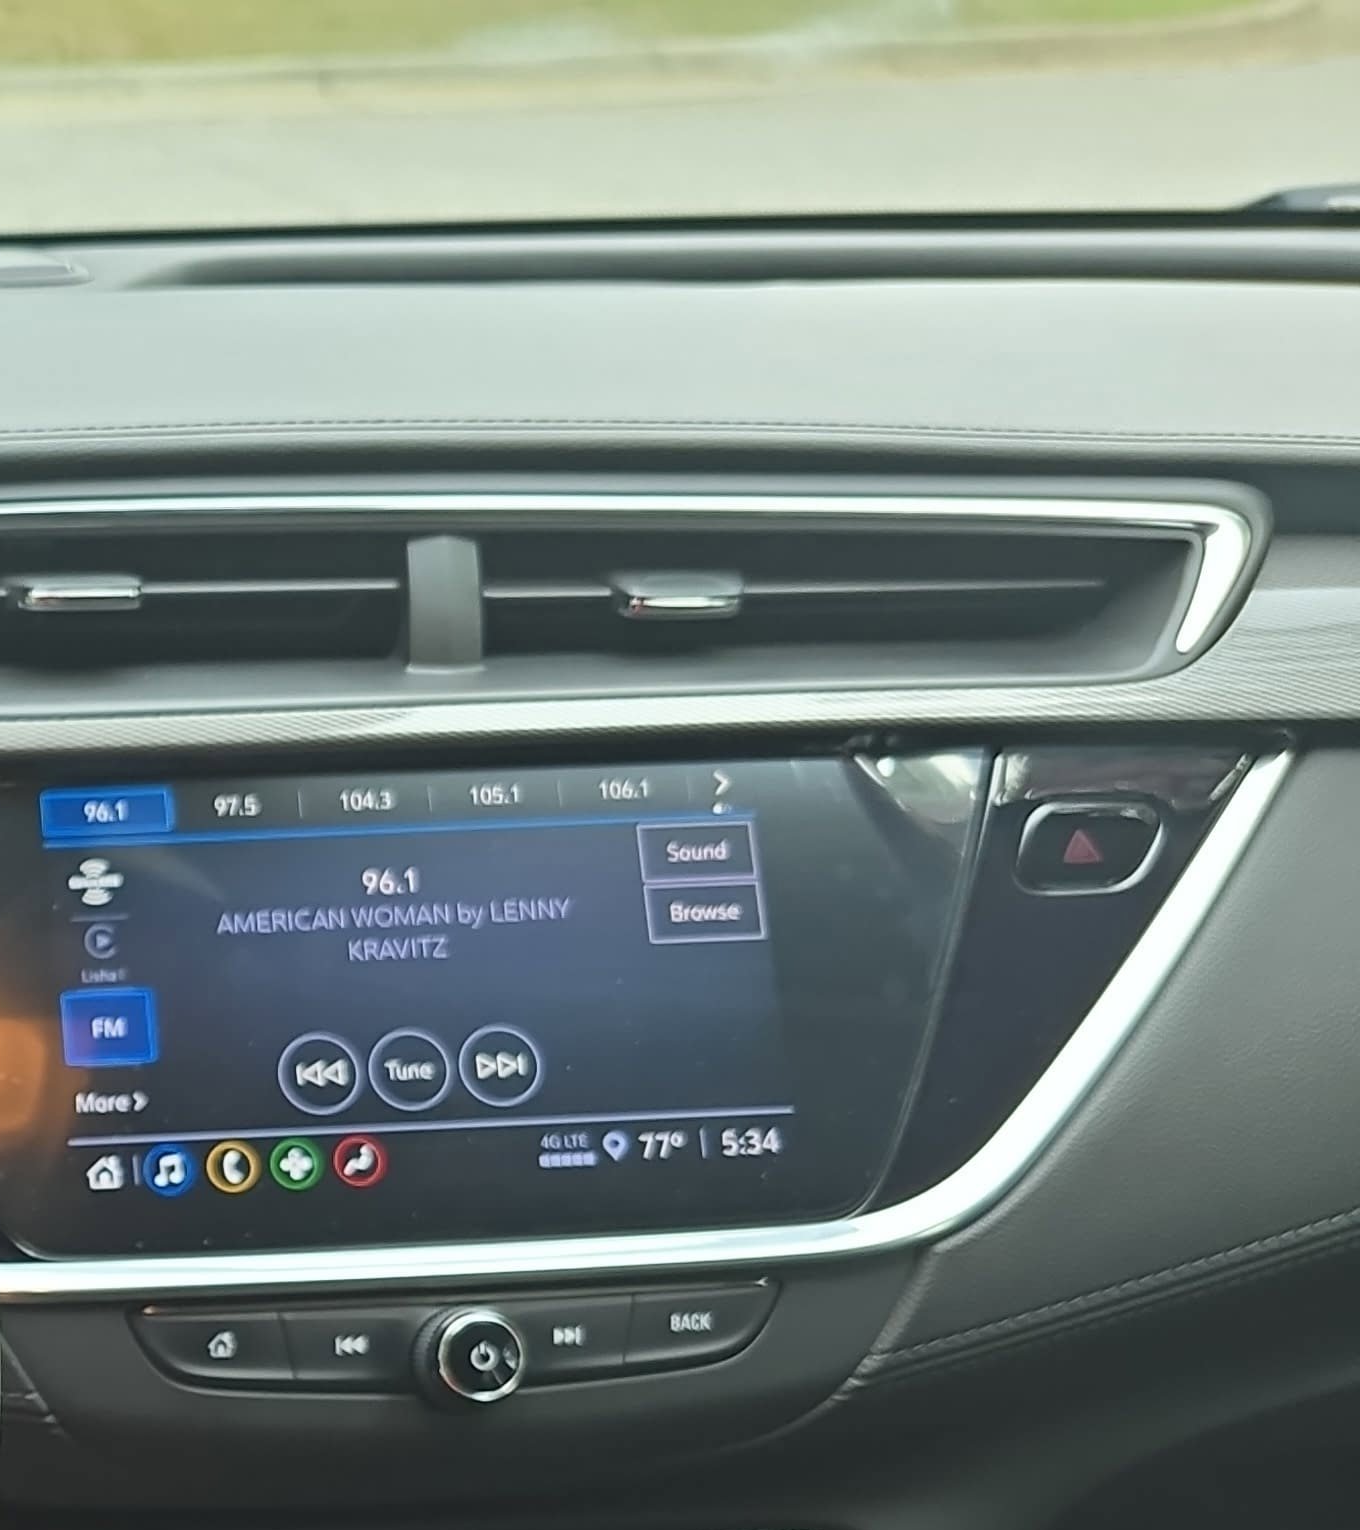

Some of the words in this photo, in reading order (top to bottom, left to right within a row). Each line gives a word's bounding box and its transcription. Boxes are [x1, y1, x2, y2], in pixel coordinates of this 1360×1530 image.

[468, 784, 520, 806] 105.1
[598, 778, 649, 800] 106.1
[214, 795, 261, 817] 97.5
[340, 790, 396, 811] 104.3
[84, 801, 130, 823] 96.1
[667, 841, 727, 863] Sound
[361, 867, 420, 895] 96.1
[217, 908, 344, 935] AMERICAN
[350, 904, 450, 931] WOMAN
[456, 902, 484, 928] by
[490, 897, 572, 924] LENNY
[670, 901, 741, 923] Browse
[348, 936, 449, 961] KRAVITZ
[92, 1017, 127, 1038] FM
[385, 1058, 434, 1081] Tune
[75, 1092, 131, 1114] More
[540, 1134, 561, 1149] 4G
[564, 1133, 589, 1148] LTE
[722, 1127, 781, 1156] 5:34
[671, 1312, 712, 1332] BACK
